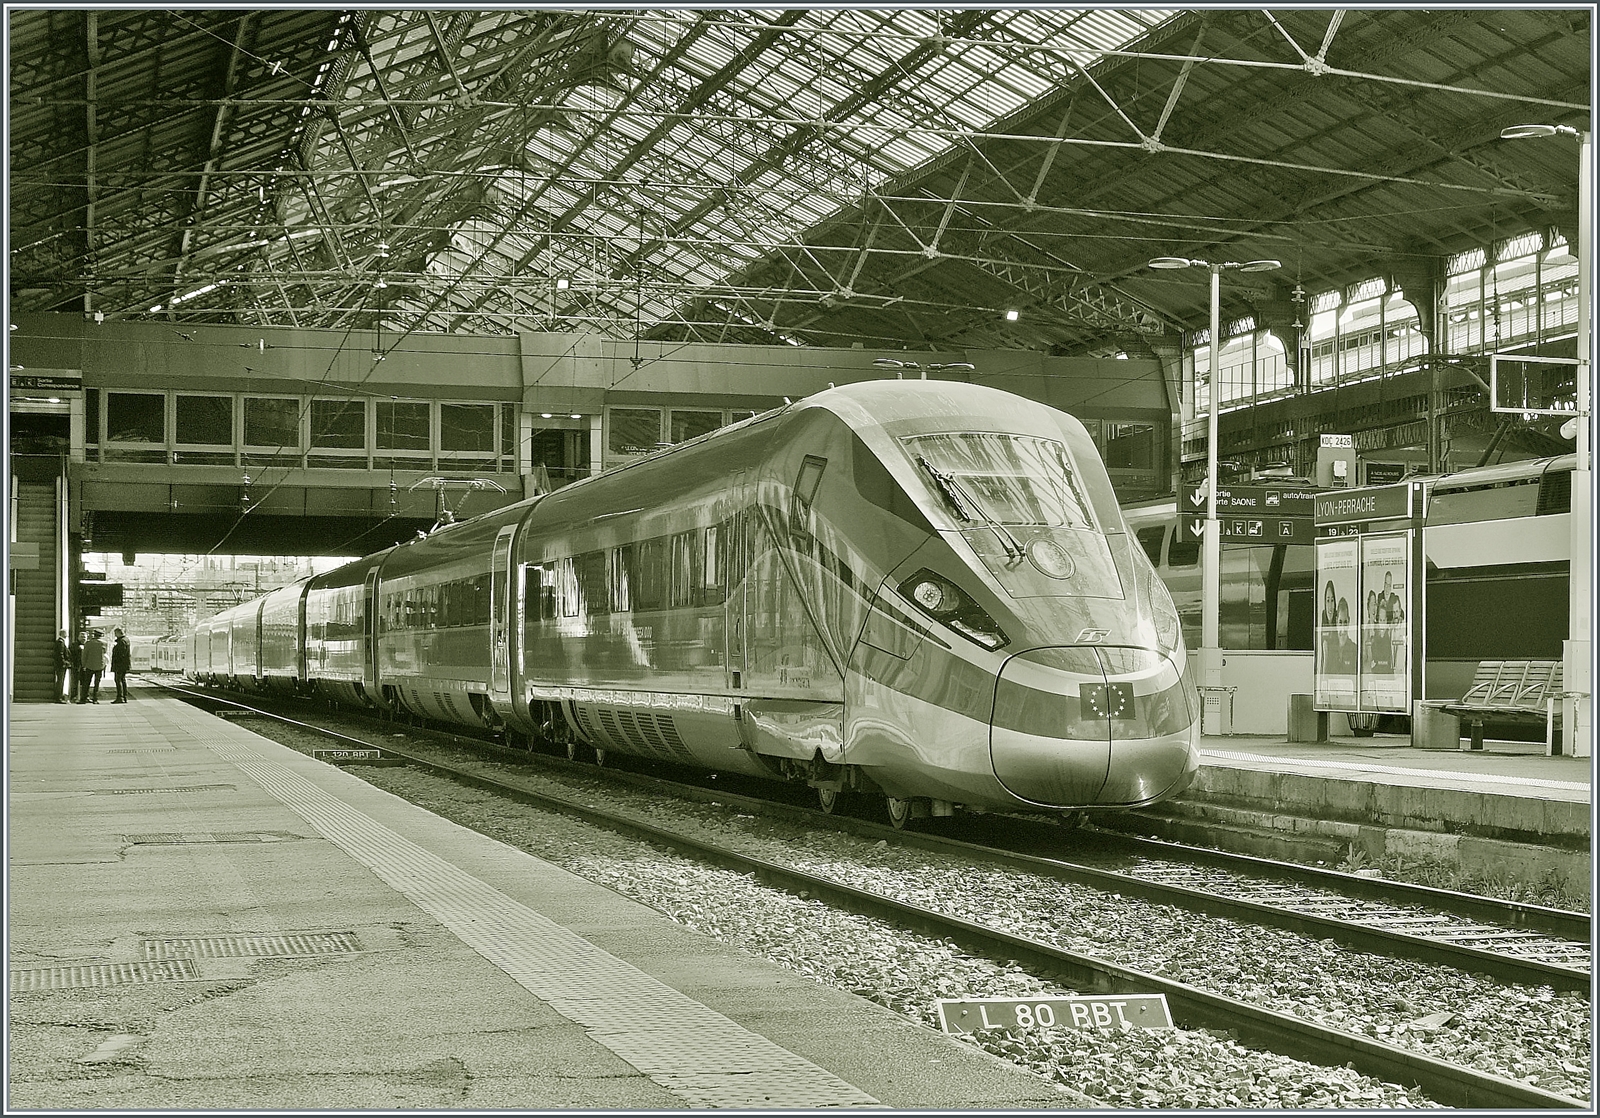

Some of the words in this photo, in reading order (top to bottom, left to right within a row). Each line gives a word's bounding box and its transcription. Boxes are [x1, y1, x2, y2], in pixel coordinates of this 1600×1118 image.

[1335, 437, 1352, 446] 2426
[1215, 490, 1231, 498] ortie
[1282, 492, 1316, 500] auto/train
[1231, 498, 1257, 507] SAONE
[1316, 496, 1376, 517] LYON-PERRACHE
[1236, 526, 1242, 534] K
[1282, 527, 1290, 535] A
[1328, 528, 1337, 536] 19
[1348, 528, 1359, 536] 23
[979, 1005, 1003, 1029] L
[1014, 1003, 1056, 1028] 80
[1069, 1001, 1128, 1028] RBT
